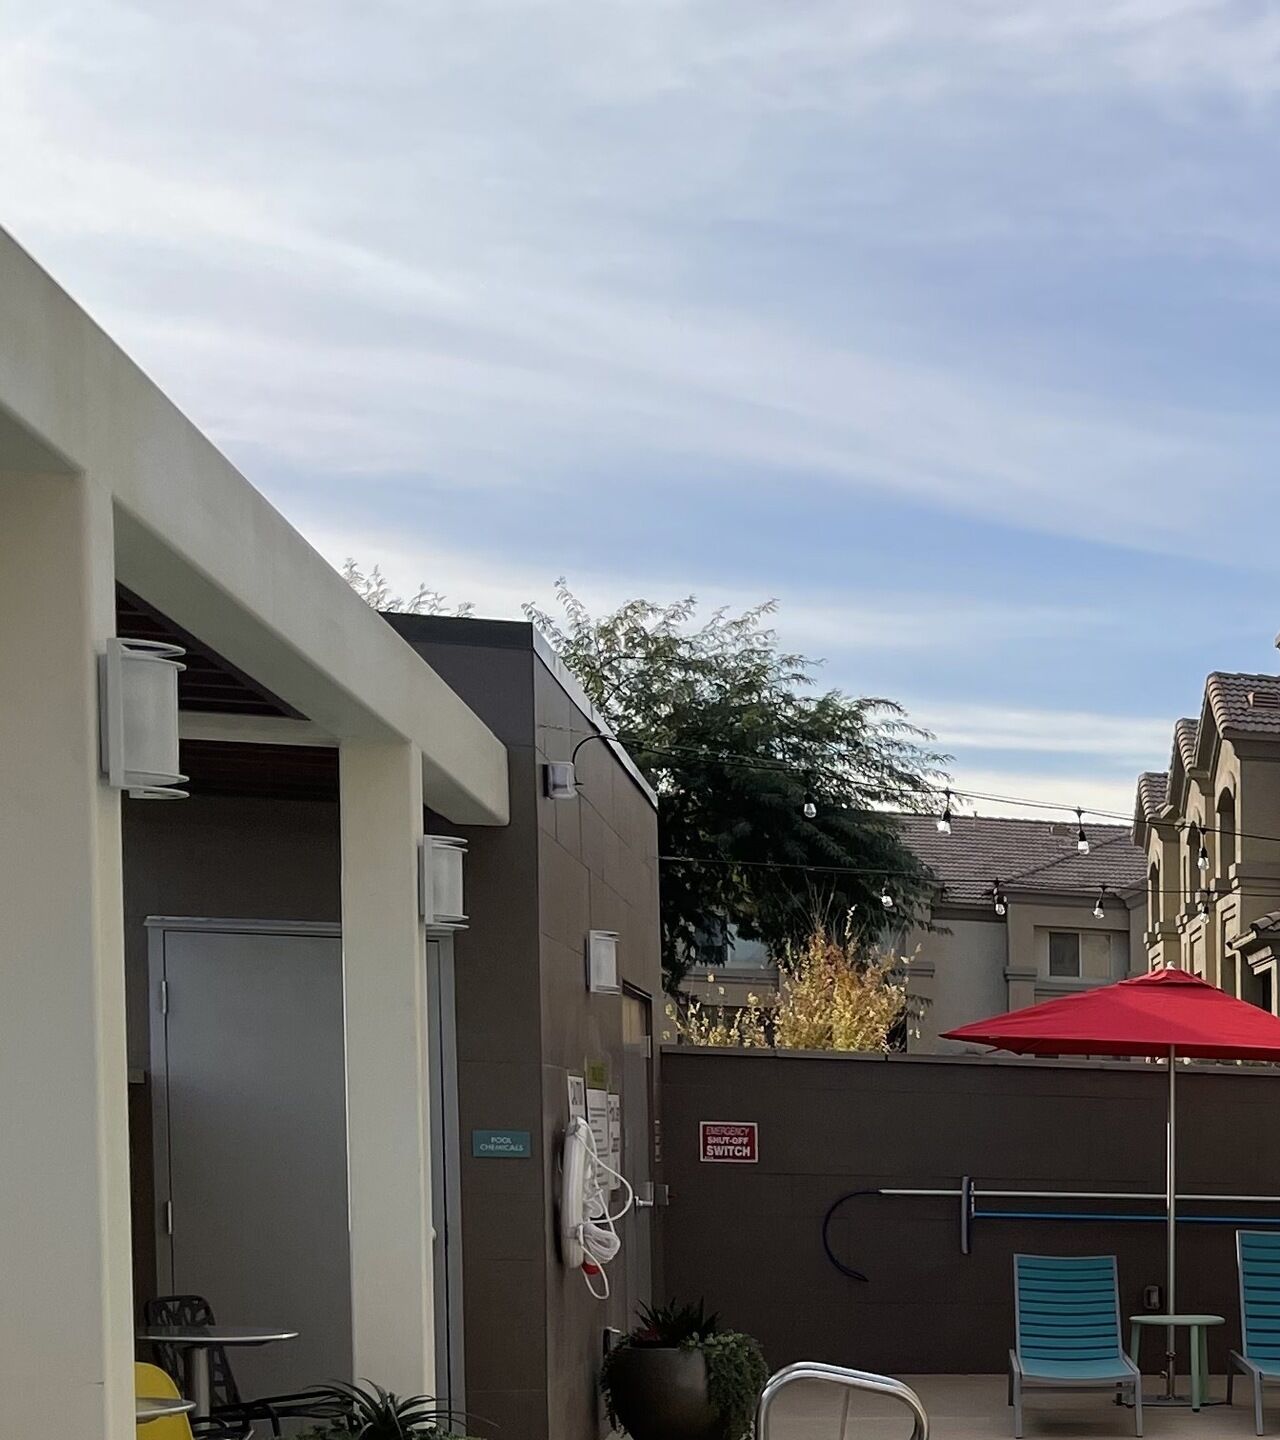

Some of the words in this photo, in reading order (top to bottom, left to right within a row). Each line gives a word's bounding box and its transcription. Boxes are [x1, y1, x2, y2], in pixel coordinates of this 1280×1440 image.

[706, 1126, 750, 1136] EMERGENCY
[491, 1136, 512, 1144] POOL
[707, 1136, 749, 1144] SHUT-OFF
[706, 1145, 750, 1157] SWITCH
